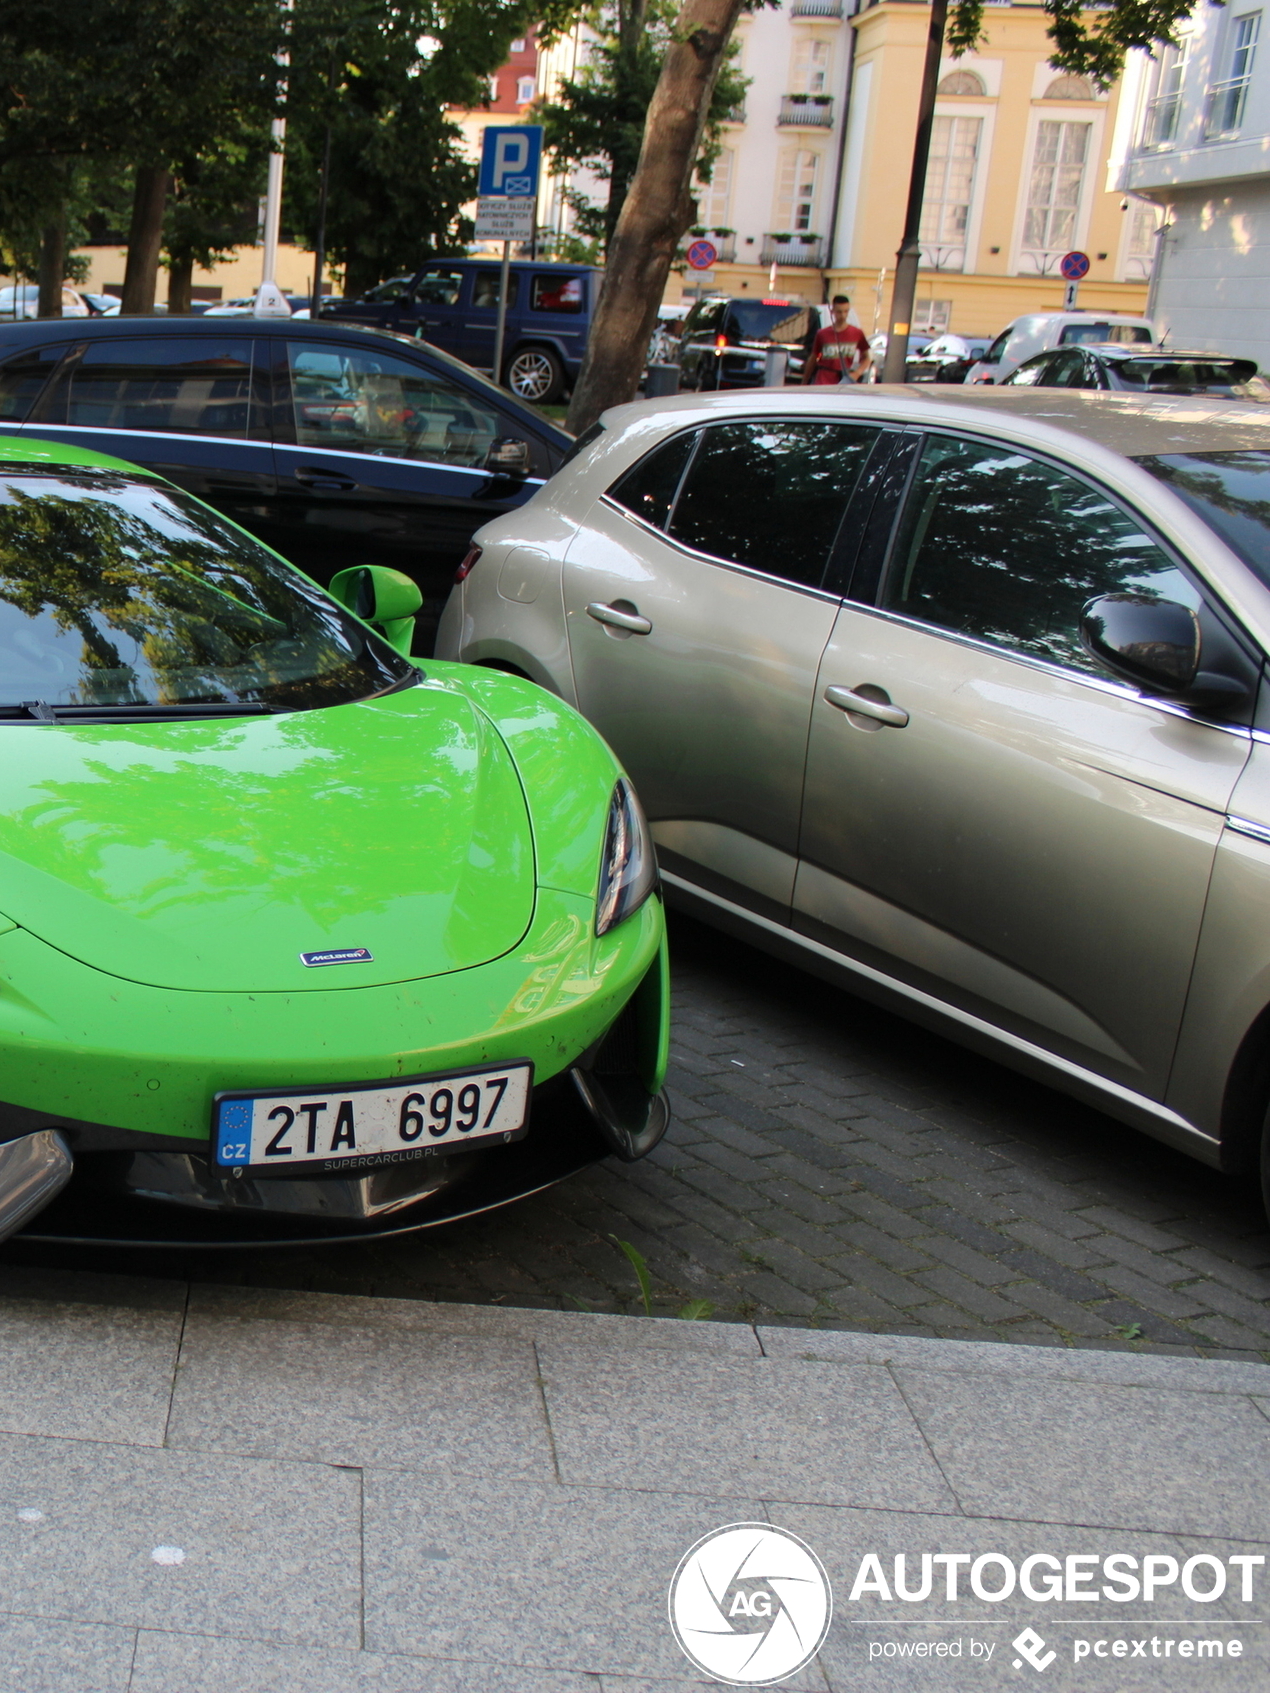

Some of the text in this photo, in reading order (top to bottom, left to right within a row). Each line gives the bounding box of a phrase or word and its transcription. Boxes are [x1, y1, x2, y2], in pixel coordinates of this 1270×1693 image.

[492, 133, 529, 188] P
[268, 298, 276, 306] 2
[310, 952, 362, 962] McLaren
[264, 1076, 509, 1157] 2TA 6997
[221, 1143, 246, 1160] CZ
[324, 1148, 439, 1171] SUPERCARCLUB.PL
